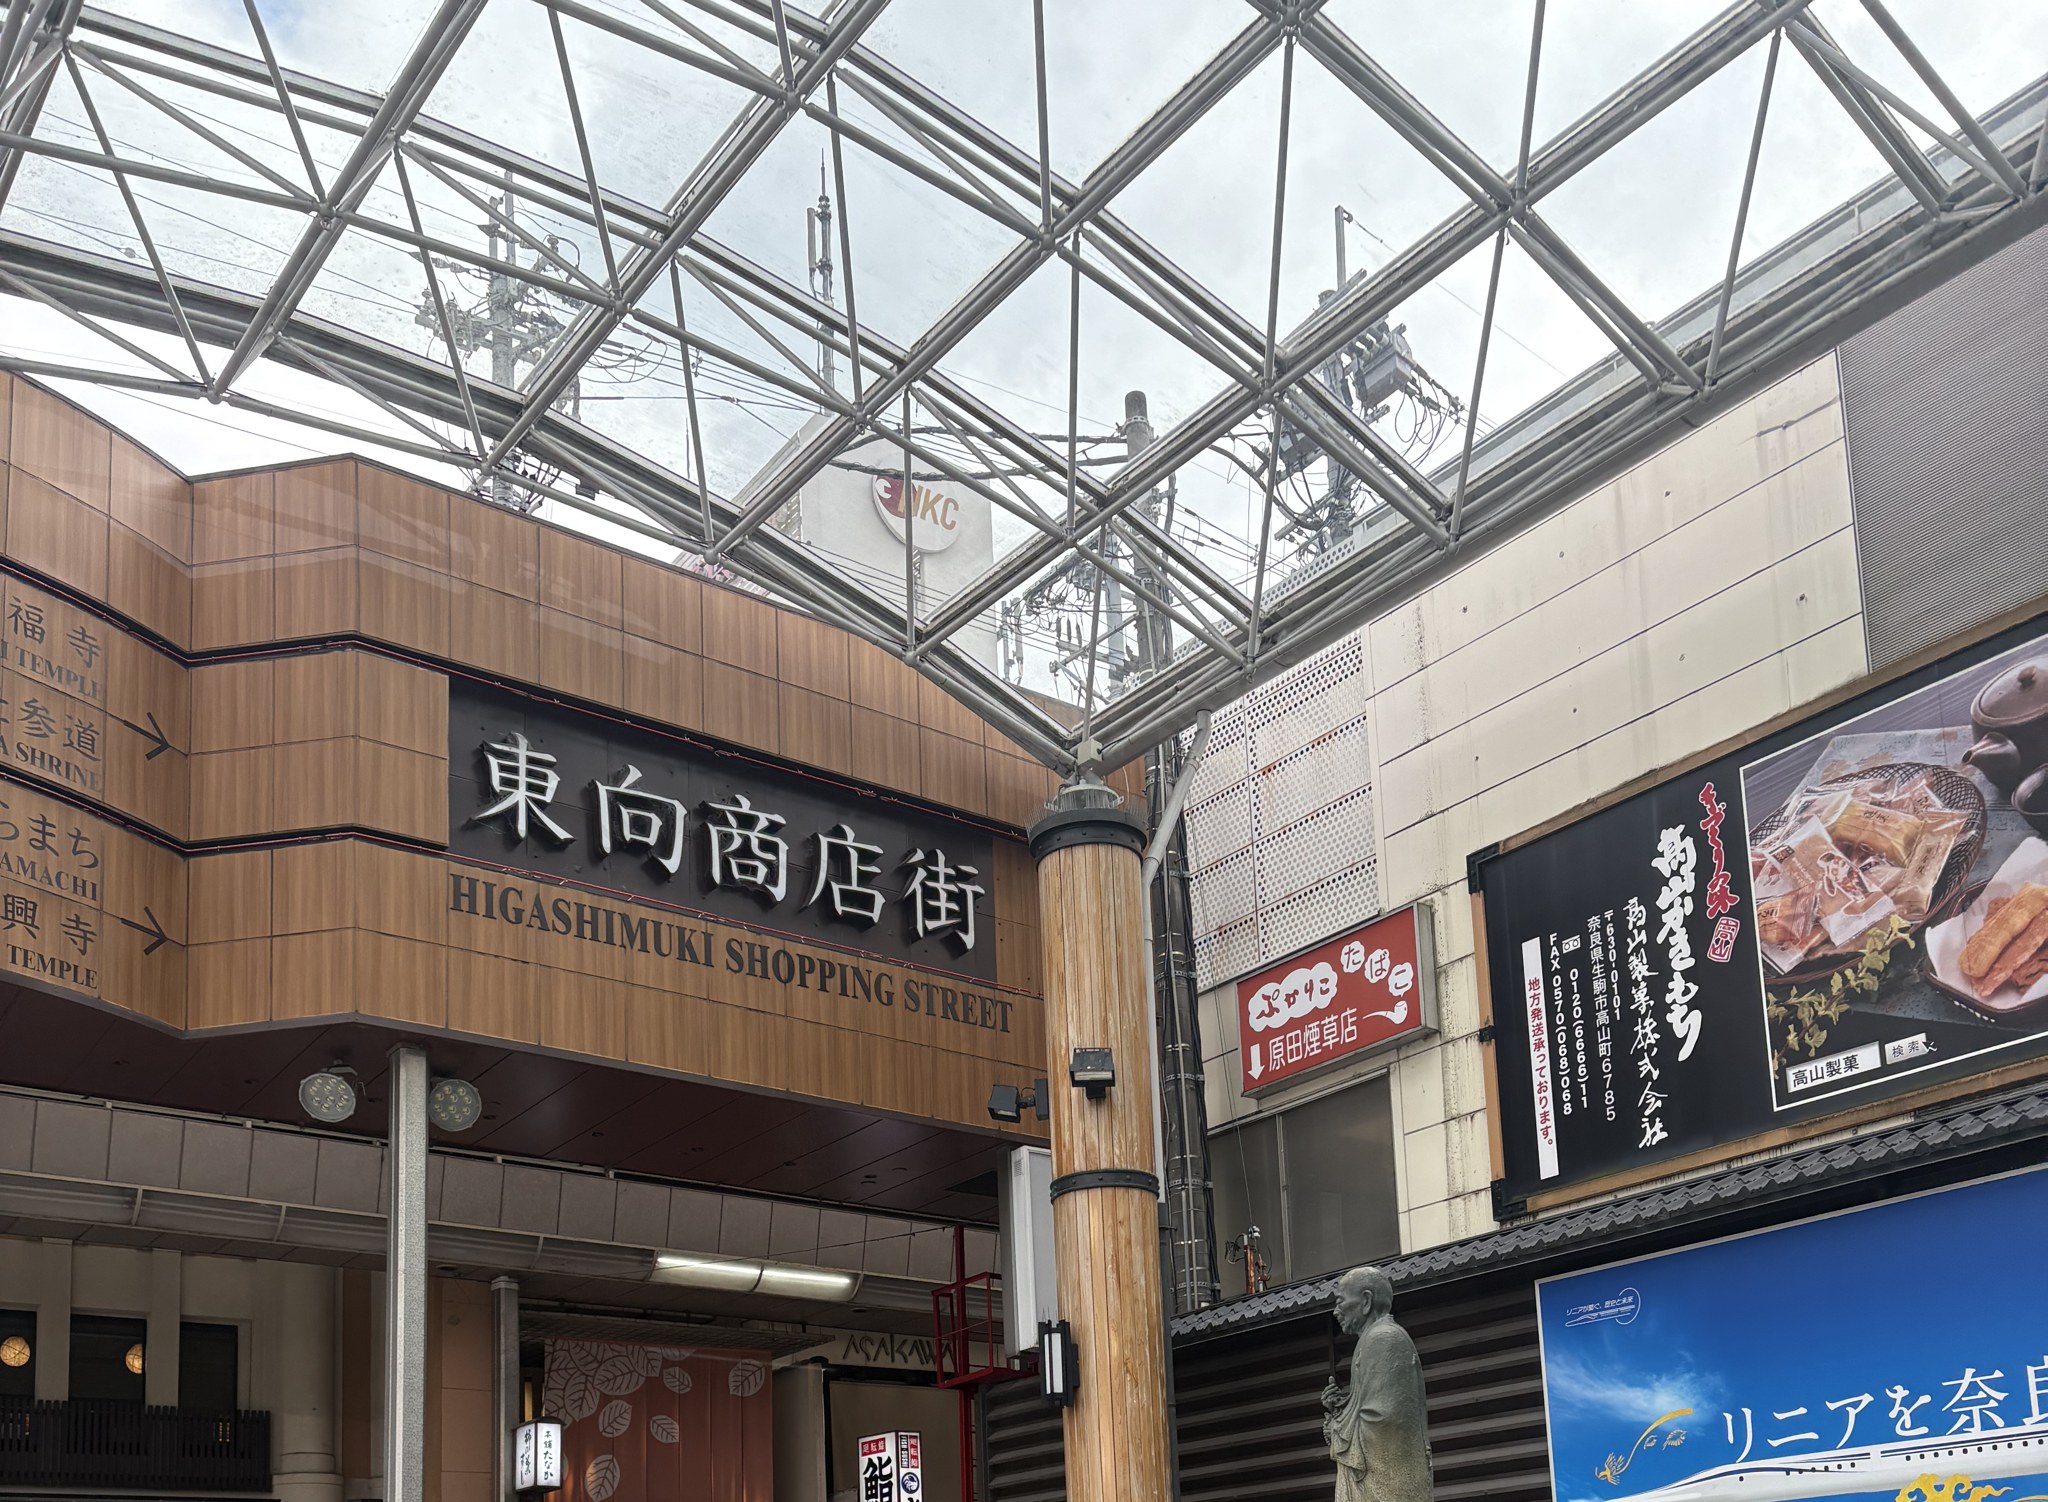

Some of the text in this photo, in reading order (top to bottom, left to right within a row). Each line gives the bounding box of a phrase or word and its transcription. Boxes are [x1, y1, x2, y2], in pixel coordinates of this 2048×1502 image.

[897, 484, 959, 531] NKC
[7, 595, 101, 669] 福寺
[470, 730, 986, 951] 東向商店街
[7, 943, 98, 990] TEMPLE
[450, 872, 1014, 1034] HIGASHIMUKI SHOPPING STREET
[1344, 945, 1409, 990] たばこ
[1549, 932, 1561, 972] FAX
[1652, 824, 1702, 1062] 高山かきもち
[1255, 977, 1330, 1021] ぷかりこ
[1587, 915, 1616, 1122] 奈良県生駒市高山町6785
[1623, 896, 1669, 1149] 高山製菓株式会社
[1268, 1007, 1358, 1072] 原田煙草店
[1528, 976, 1553, 1146] 地方発送承っております。
[1792, 1054, 1860, 1088] 高山製菓
[1892, 1040, 1919, 1058] 検索
